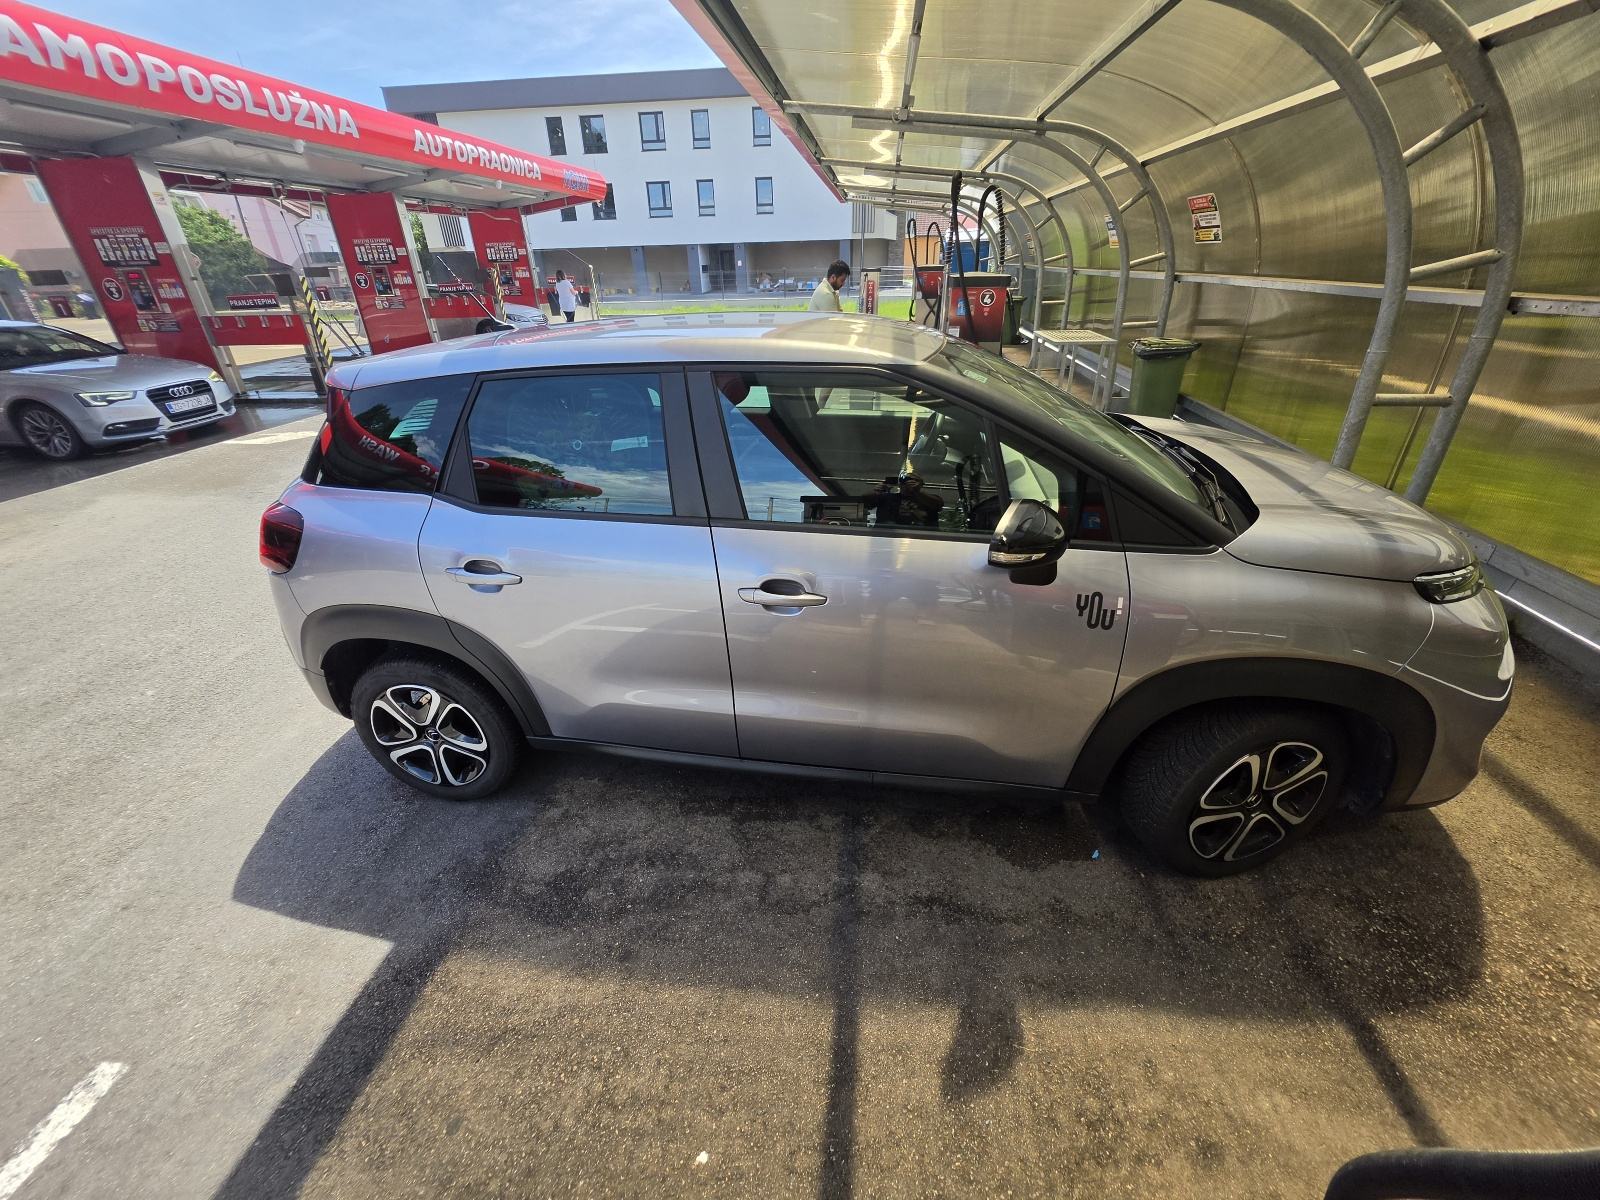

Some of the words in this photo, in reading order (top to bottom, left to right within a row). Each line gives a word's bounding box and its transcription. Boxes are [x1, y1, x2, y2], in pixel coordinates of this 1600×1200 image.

[413, 128, 542, 181] AUTOPRAONICA
[359, 279, 366, 287] 2
[109, 287, 119, 298] 3
[229, 299, 254, 307] PRANJE
[255, 298, 277, 306] TEPIHA
[983, 294, 992, 305] 4
